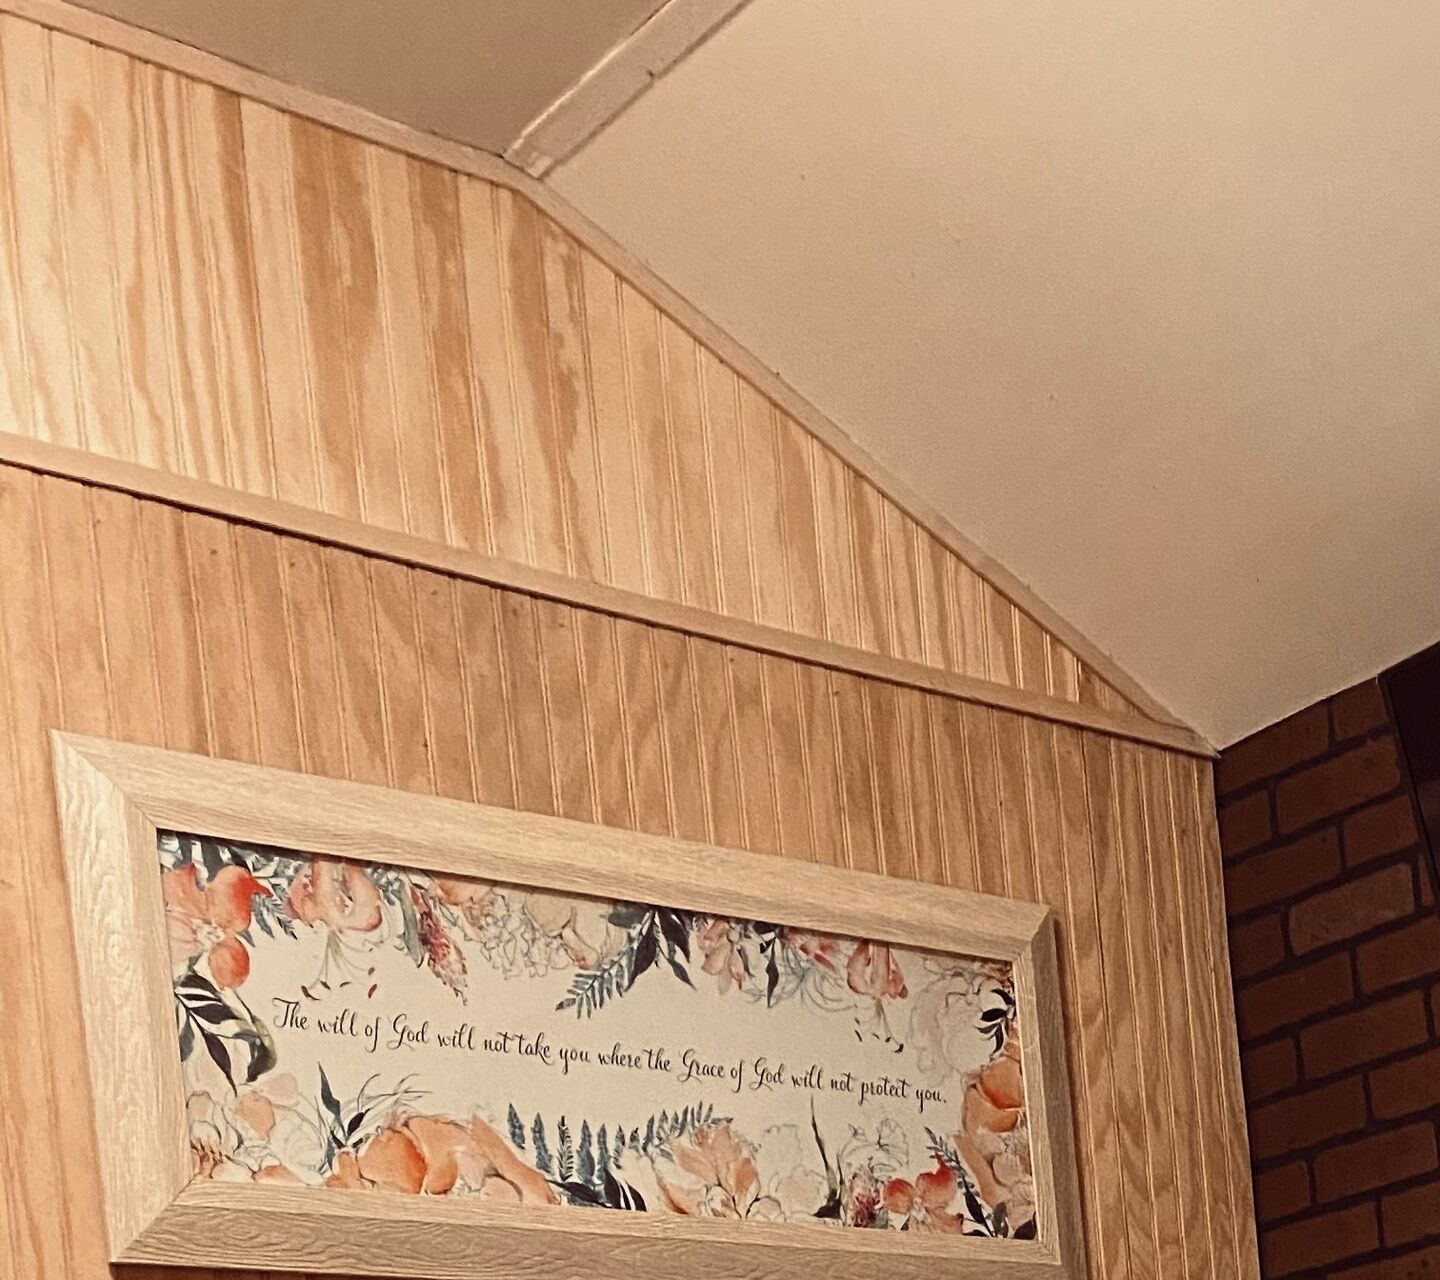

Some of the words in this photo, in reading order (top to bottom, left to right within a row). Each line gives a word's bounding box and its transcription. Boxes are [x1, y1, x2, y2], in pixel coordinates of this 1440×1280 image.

[273, 997, 309, 1030] The
[317, 1008, 359, 1038] will
[364, 1015, 380, 1054] of
[387, 1013, 430, 1051] God
[437, 1022, 476, 1051] will
[483, 1031, 514, 1055] not
[516, 1032, 553, 1066] take
[559, 1046, 590, 1076] you
[598, 1043, 642, 1071] where
[641, 1048, 672, 1073] the
[677, 1049, 724, 1084] Grace
[730, 1059, 744, 1094] of
[749, 1057, 786, 1092] God
[791, 1064, 824, 1091] will
[830, 1071, 857, 1094] not
[860, 1076, 911, 1106] protect
[915, 1085, 948, 1115] you.
